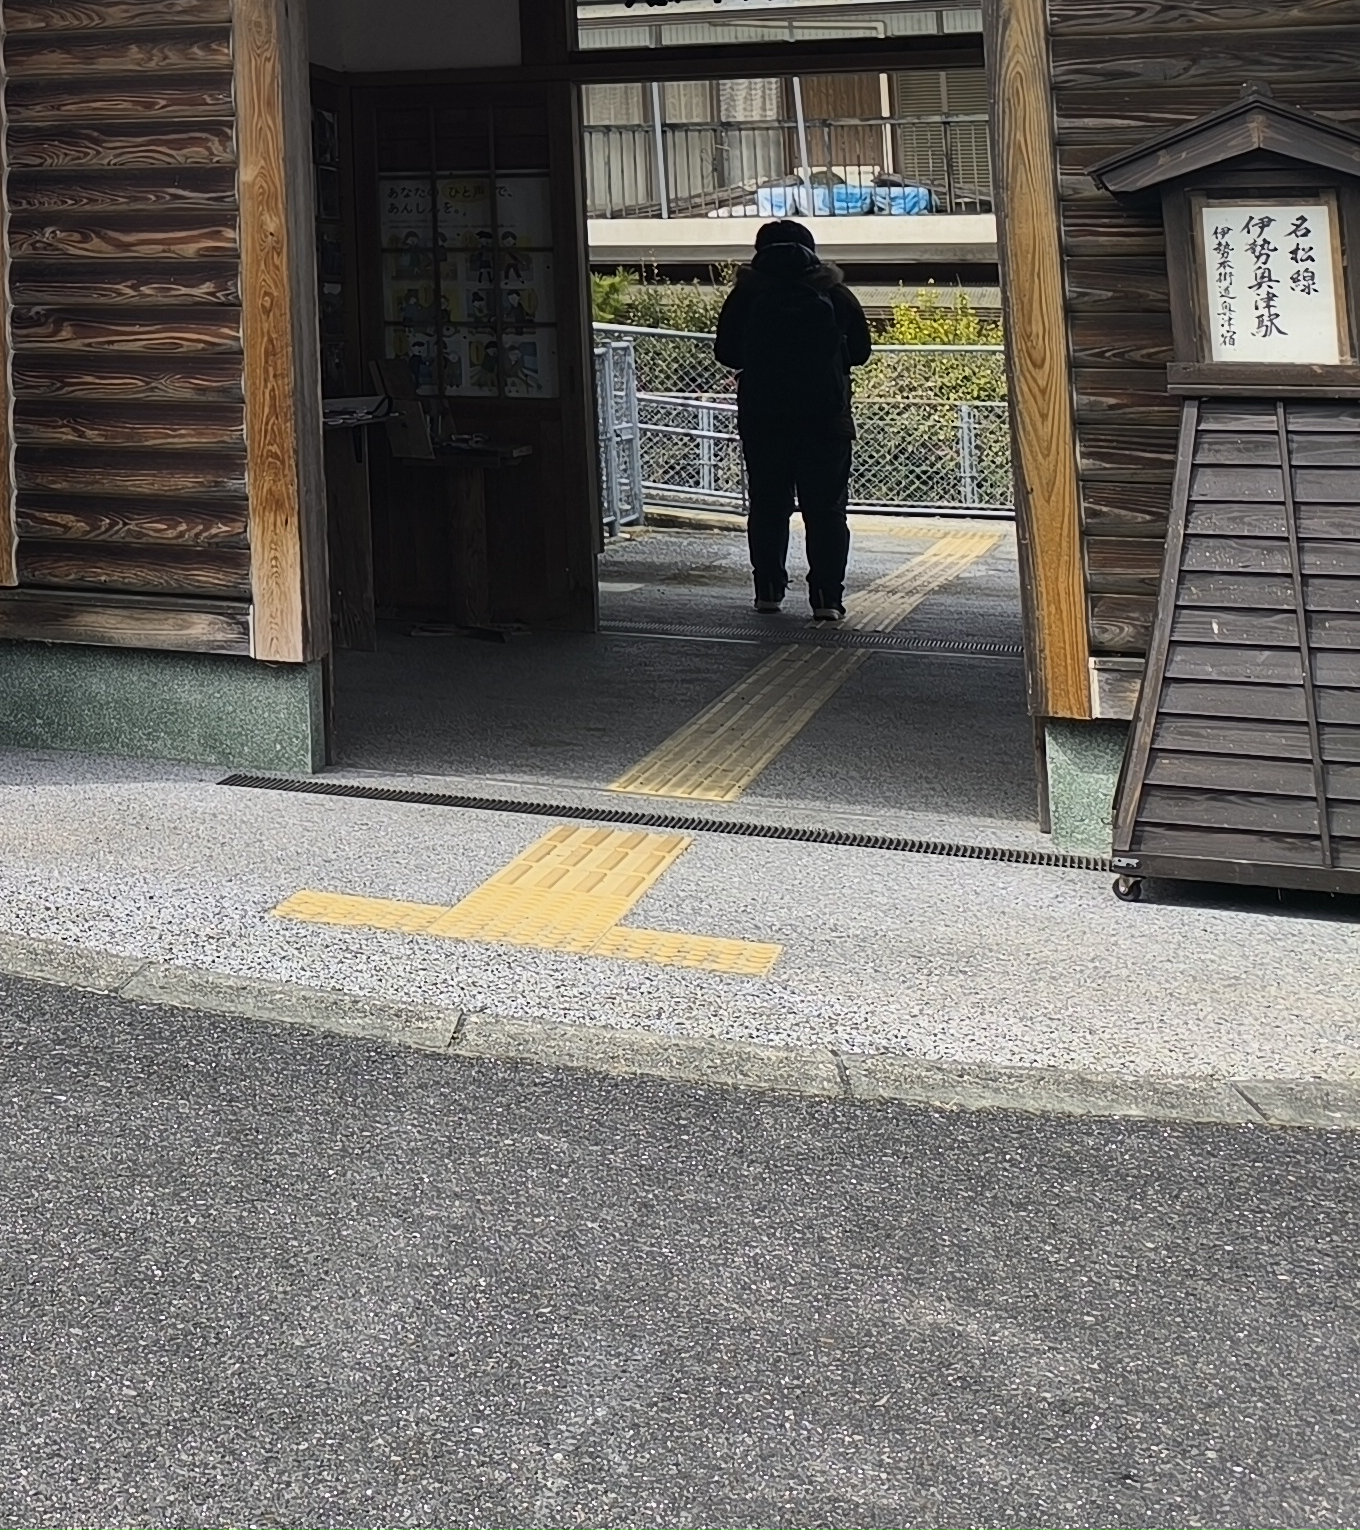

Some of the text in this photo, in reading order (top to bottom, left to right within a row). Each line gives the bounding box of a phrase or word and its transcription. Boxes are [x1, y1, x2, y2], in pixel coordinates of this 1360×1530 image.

[1240, 215, 1288, 338] 伊勢奥津駅
[1284, 214, 1319, 296] 名松線
